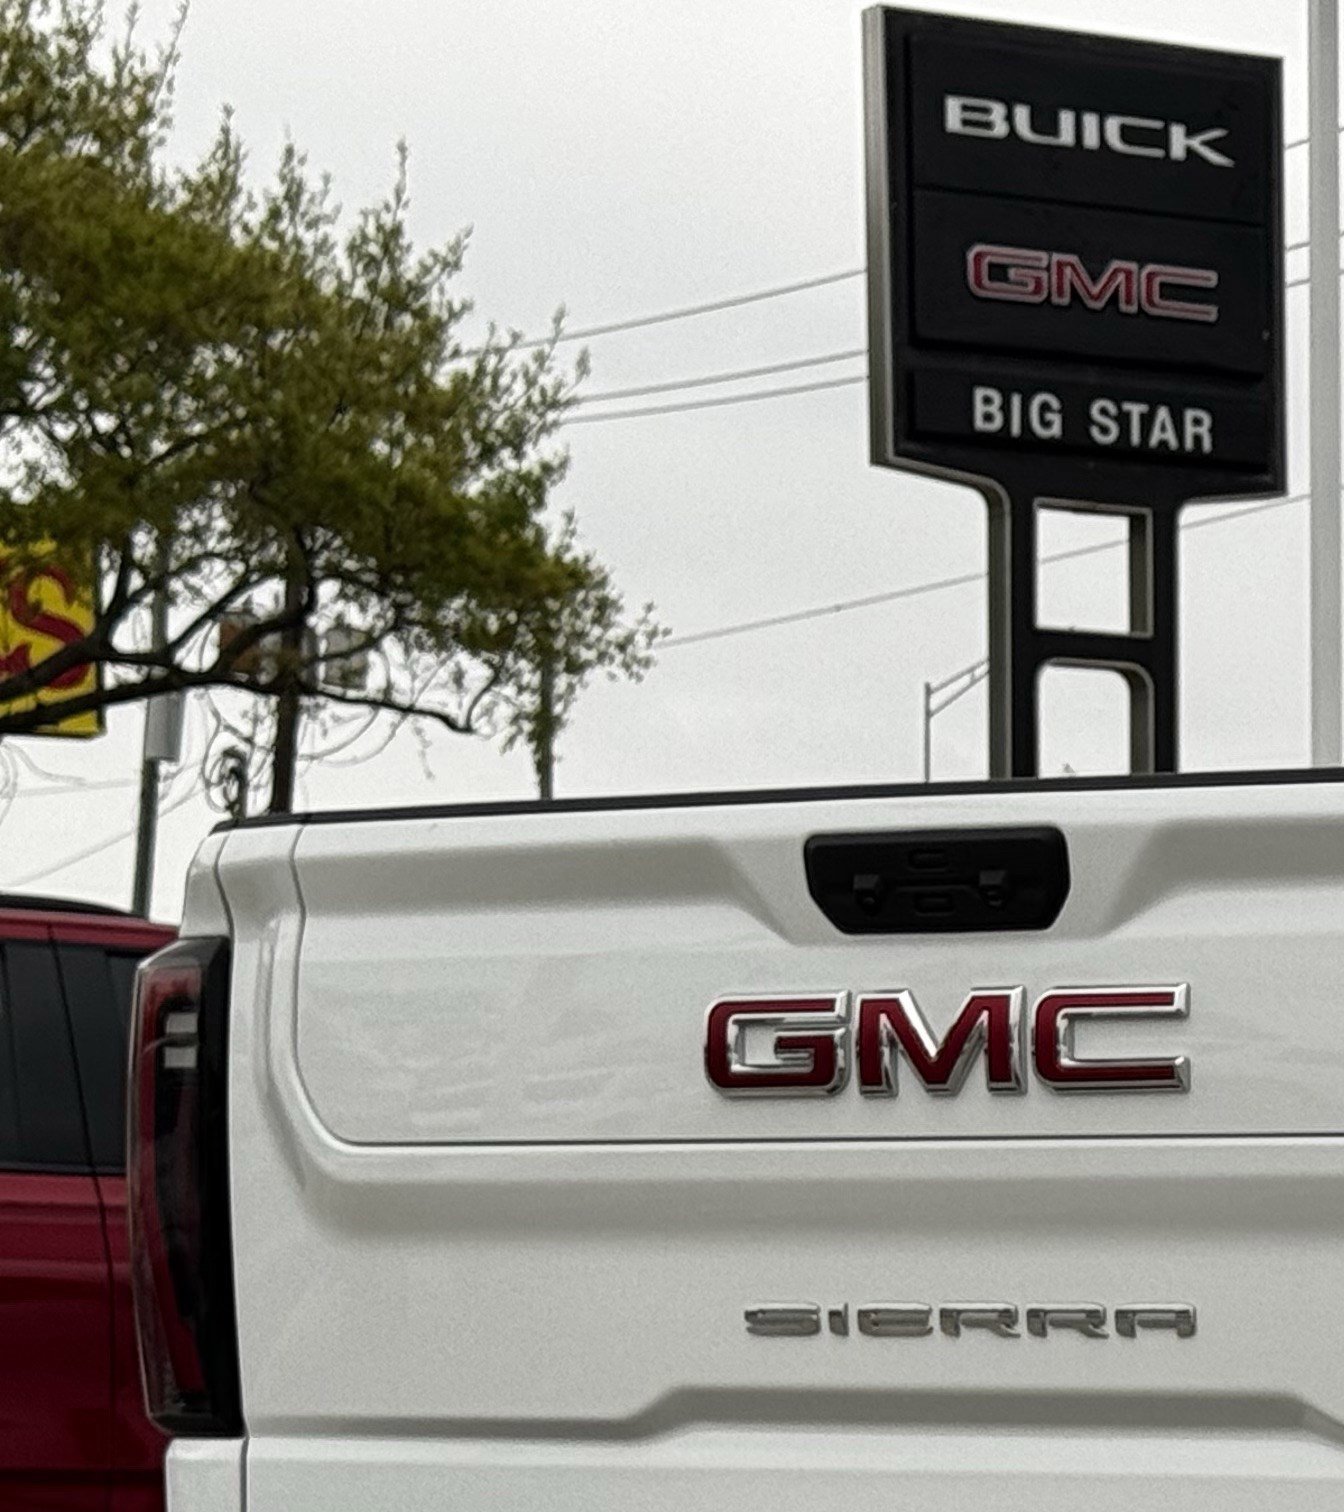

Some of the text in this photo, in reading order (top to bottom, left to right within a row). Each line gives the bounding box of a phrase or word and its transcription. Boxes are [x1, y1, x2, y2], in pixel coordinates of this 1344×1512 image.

[944, 94, 1235, 167] BUICK
[966, 244, 1218, 323] GMC
[972, 386, 1213, 454] BIG STAR
[704, 982, 1191, 1097] GMC
[744, 1302, 1198, 1338] SIERRA
